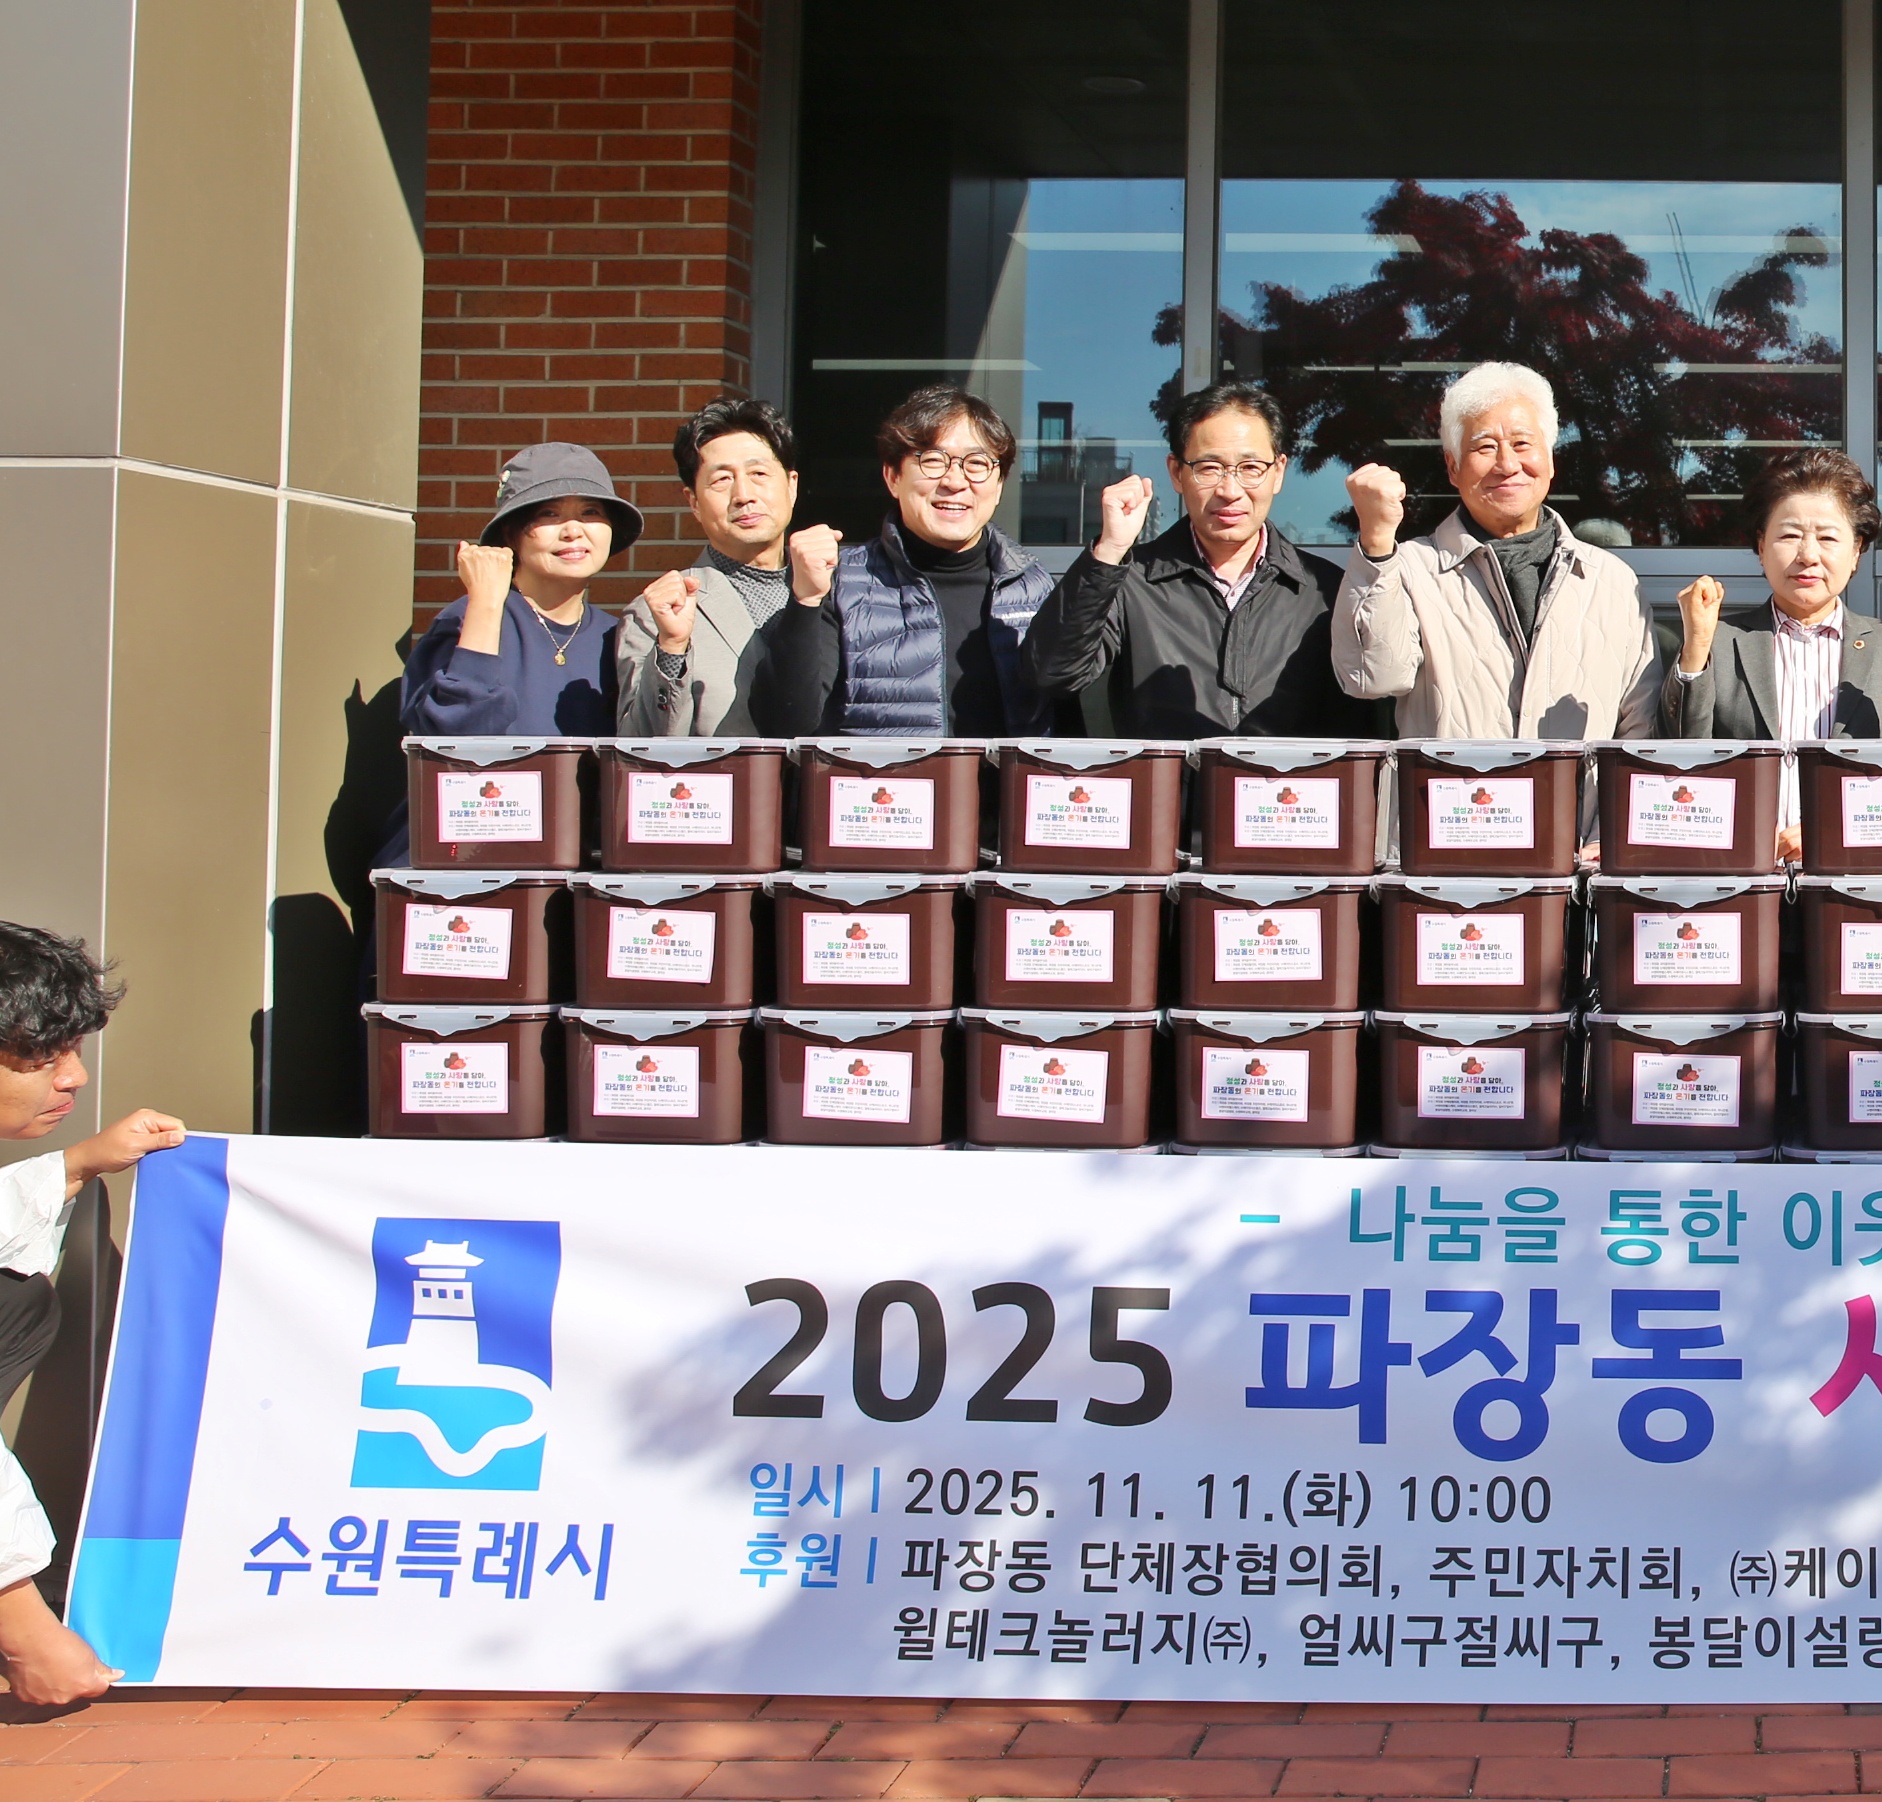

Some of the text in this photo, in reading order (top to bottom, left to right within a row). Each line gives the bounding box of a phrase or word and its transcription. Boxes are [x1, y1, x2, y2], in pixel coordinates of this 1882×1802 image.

[501, 808, 530, 817] 전합니다
[1089, 814, 1119, 824] 전합니다
[1692, 814, 1723, 824] 전합니다
[672, 948, 702, 957] 전합니다
[1279, 947, 1310, 955] 전합니다
[868, 1087, 899, 1098] 전합니다
[1483, 1085, 1513, 1094] 전합니다
[1348, 1185, 1566, 1264] 나눔을
[1600, 1189, 1748, 1267] 통한
[732, 1278, 1173, 1428] 2025
[1237, 1288, 1743, 1464] 파장동
[749, 1462, 845, 1519] 일시
[904, 1467, 1055, 1519] 2025.
[1088, 1472, 1164, 1521] 11.
[1197, 1469, 1372, 1529] 11.(화)
[1399, 1475, 1551, 1524] 10:00
[243, 1515, 614, 1601] 수원특례시
[740, 1532, 843, 1590] 후원
[900, 1537, 1052, 1594] 파장동
[1080, 1541, 1400, 1601] 단체장협의회,
[1429, 1546, 1701, 1602] 주민자치회,
[1299, 1613, 1620, 1671] 얼씨구절씨구,
